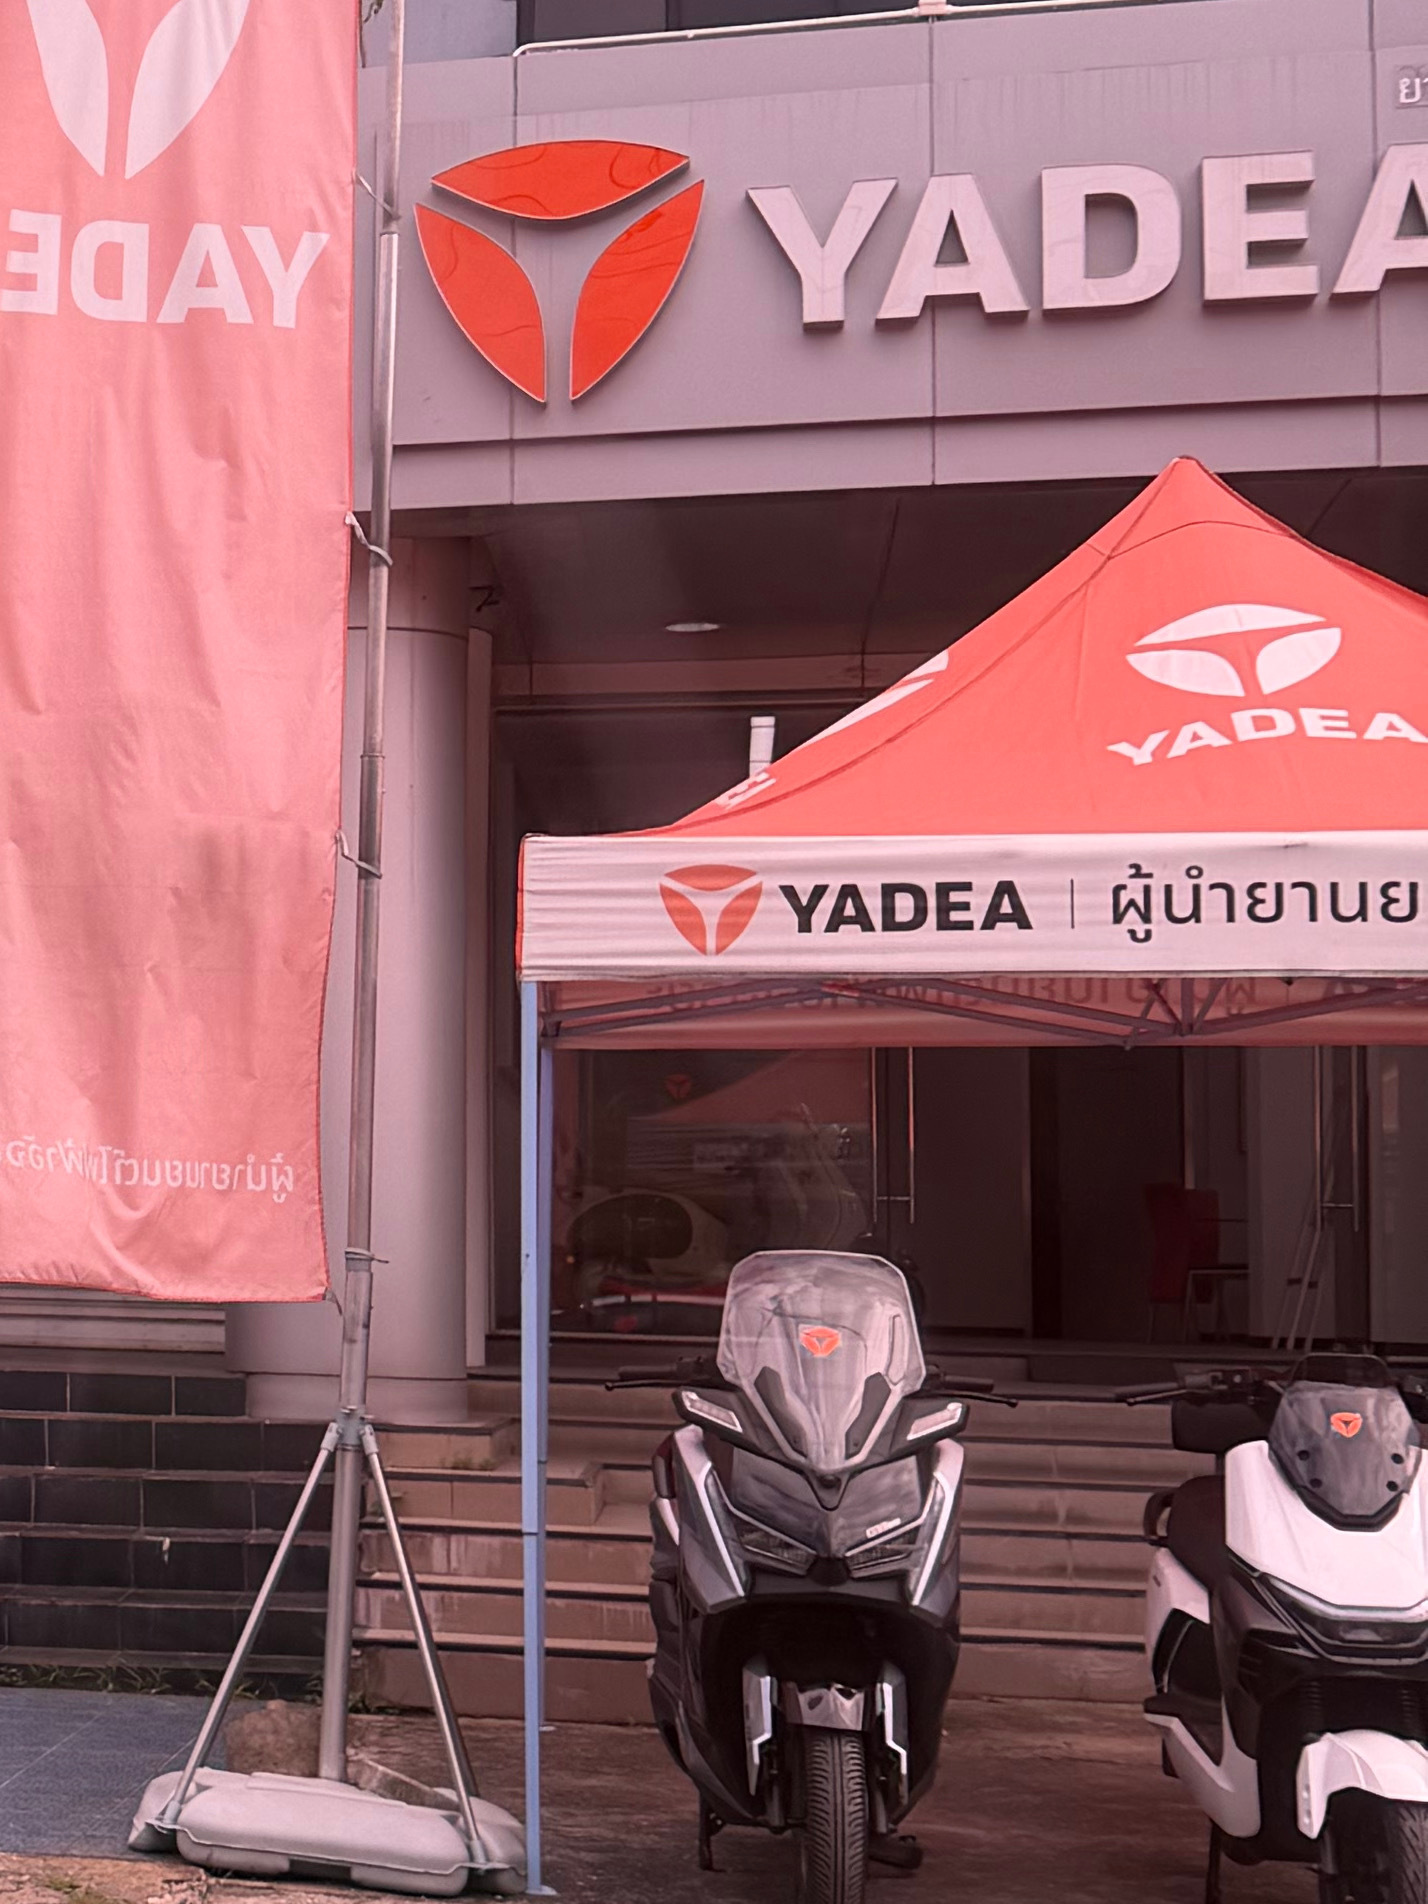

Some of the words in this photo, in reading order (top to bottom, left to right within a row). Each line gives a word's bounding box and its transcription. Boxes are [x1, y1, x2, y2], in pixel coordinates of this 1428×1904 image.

[747, 143, 1428, 330] YADEA
[1106, 707, 1428, 766] YADEA
[779, 880, 1033, 934] YADEA
[1111, 863, 1420, 944] ผู้นำยานย
